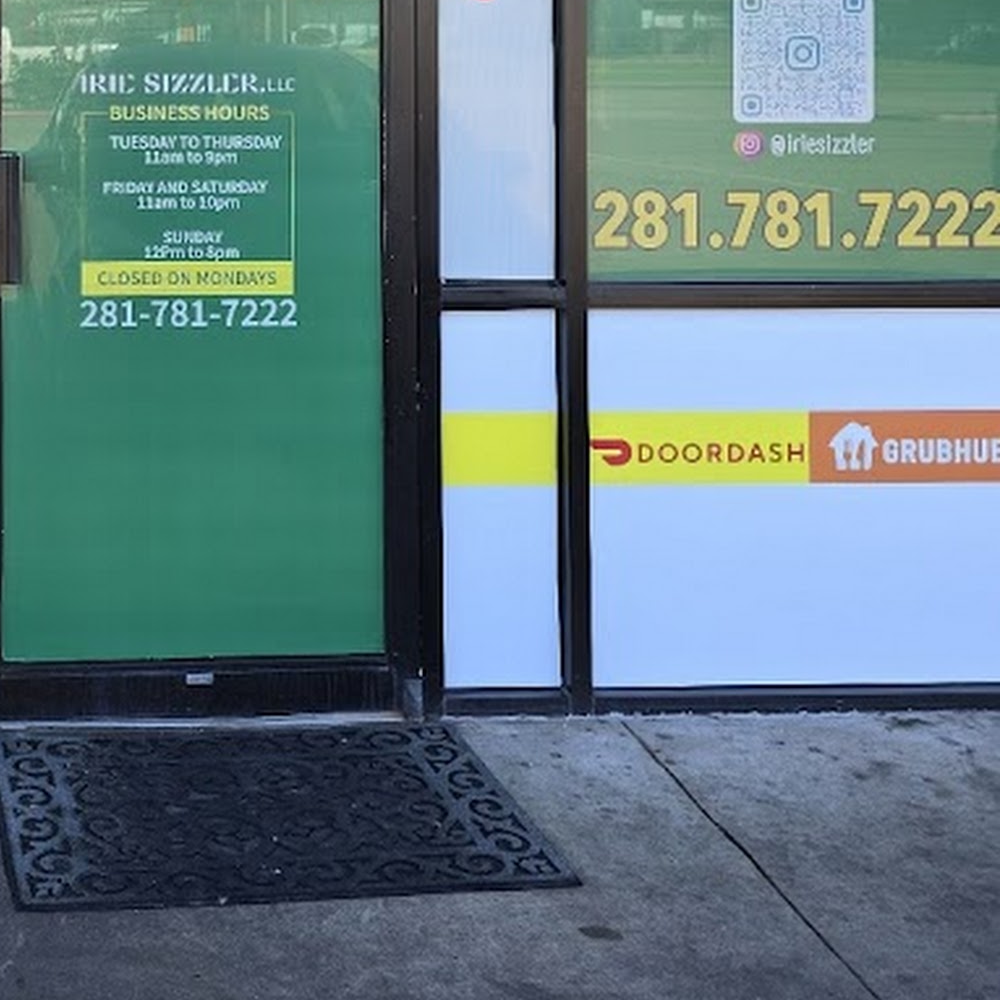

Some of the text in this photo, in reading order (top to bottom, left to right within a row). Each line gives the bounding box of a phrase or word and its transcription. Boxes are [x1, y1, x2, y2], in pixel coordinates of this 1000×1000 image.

[80, 72, 136, 95] IRIE
[109, 104, 271, 122] BUSINESS HOURS
[109, 134, 283, 151] TUESDAY TO THURSDAY
[770, 132, 877, 158] @iriesizzler
[145, 151, 185, 166] 11am
[187, 151, 204, 165] to
[102, 180, 269, 195] FRIDAY AND SATURDAY
[136, 195, 241, 212] 11am to 10pm
[592, 188, 1000, 250] 281.781.7222
[162, 230, 224, 245] SUNDAY
[188, 246, 204, 260] to
[97, 270, 278, 286] CLOSED ON MONDAYS
[80, 299, 299, 329] 281-781-7222
[637, 442, 805, 464] DOORDASH
